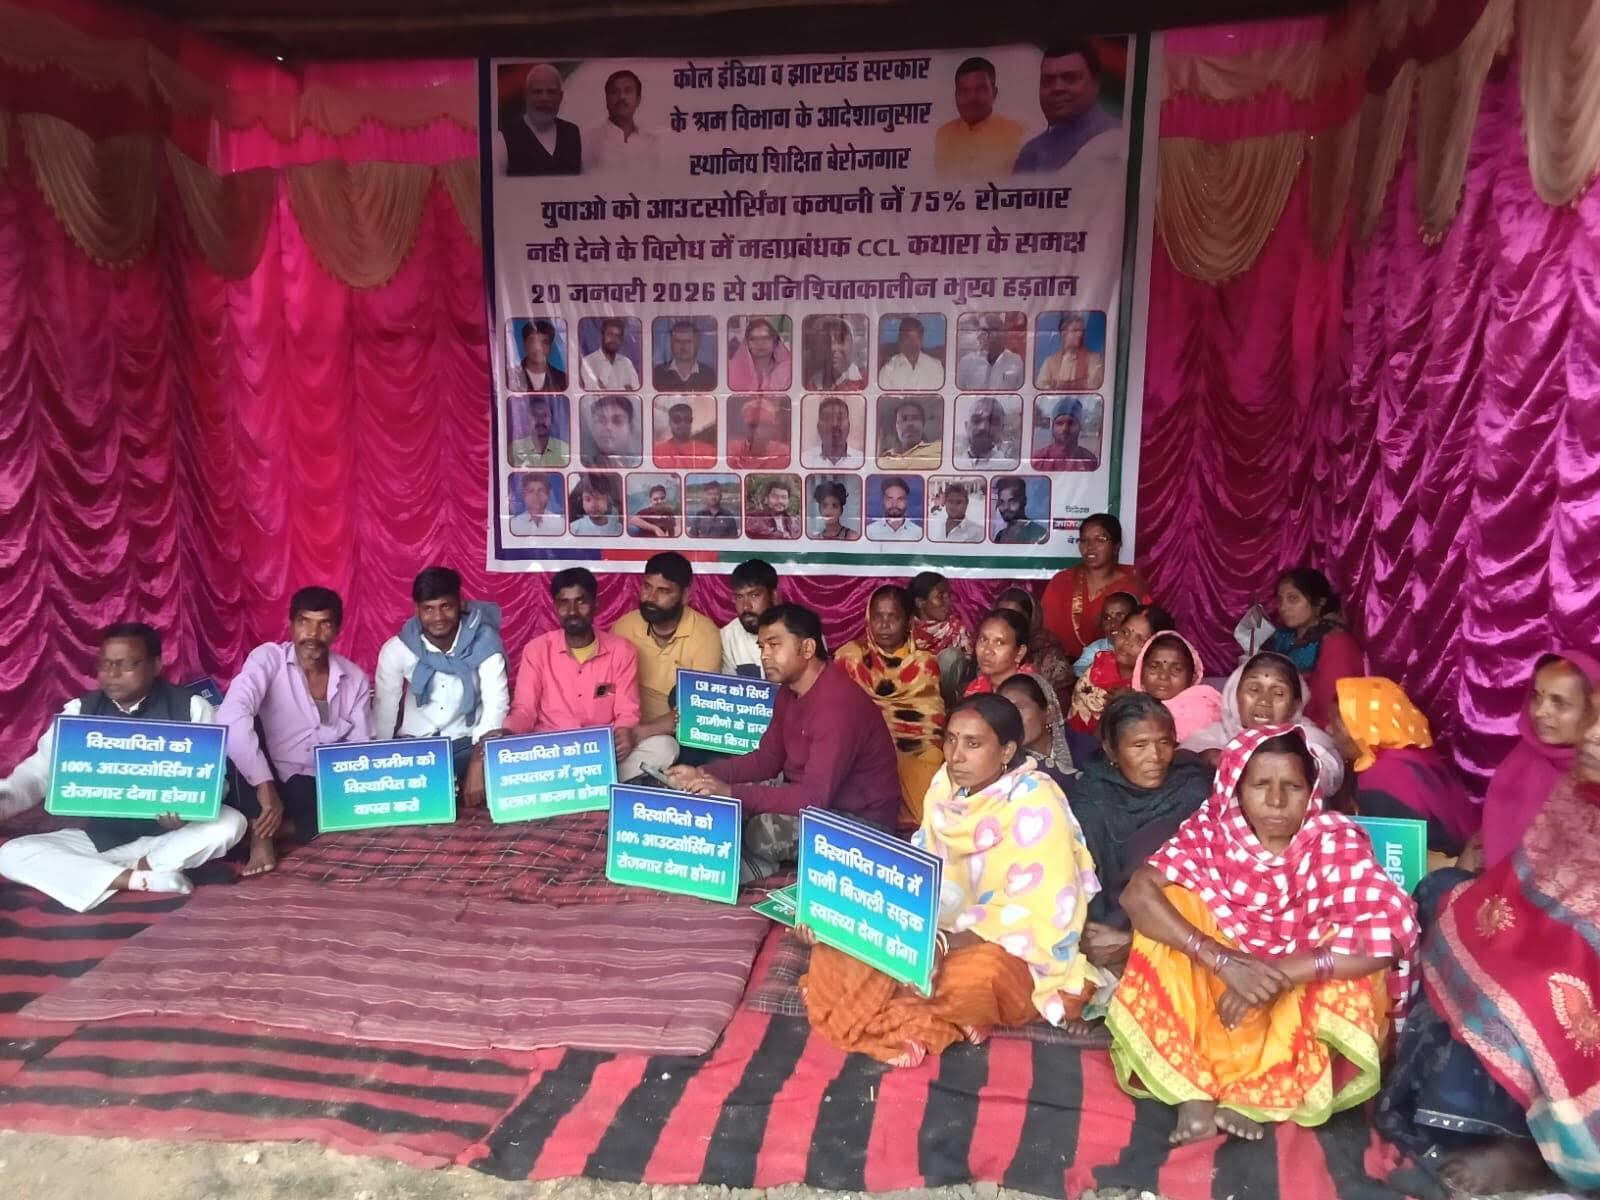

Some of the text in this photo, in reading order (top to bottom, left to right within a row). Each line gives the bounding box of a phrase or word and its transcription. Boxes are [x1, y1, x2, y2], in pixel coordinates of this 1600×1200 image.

[673, 56, 932, 89] कोल इंडिया व झारखंड सरकार
[670, 99, 933, 133] के श्रम विभाग के आदेशानुसार
[761, 146, 823, 174] शिक्षित
[826, 142, 912, 172] बेरोजगार
[541, 195, 607, 229] युवाओ
[611, 192, 641, 220] को
[791, 186, 875, 215] कम्पनी
[910, 190, 966, 213] 75%
[975, 182, 1072, 211] रोजगार
[526, 225, 1088, 263] नही देने के विरोध में महाप्रबंधक CCL कथारा के समक्ष
[531, 271, 1080, 306] 20 जनवरी 2026 से अनिश्चितकालीन भुख हड़ताल
[690, 694, 735, 713] विस्थापित
[729, 684, 744, 697] को
[746, 685, 770, 700] सिर्फ
[733, 718, 746, 730] के
[86, 732, 193, 754] विस्थापितो को
[498, 745, 560, 765] विस्थापितो
[562, 742, 581, 757] को
[724, 733, 749, 748] किया
[60, 760, 93, 773] 100%
[196, 763, 215, 780] में
[331, 751, 436, 773] खाली जमीन को
[60, 782, 123, 801] रोजगार
[126, 784, 158, 802] देना
[407, 773, 427, 790] को
[632, 802, 713, 831] विस्थापितो को
[616, 830, 640, 845] 100%
[717, 841, 732, 859] में
[664, 858, 689, 878] देना
[814, 834, 875, 876] विस्थापित
[906, 873, 924, 897] में
[807, 867, 925, 933] पानी बिजली सड़क
[857, 918, 884, 949] देना
[886, 933, 919, 965] होगा
